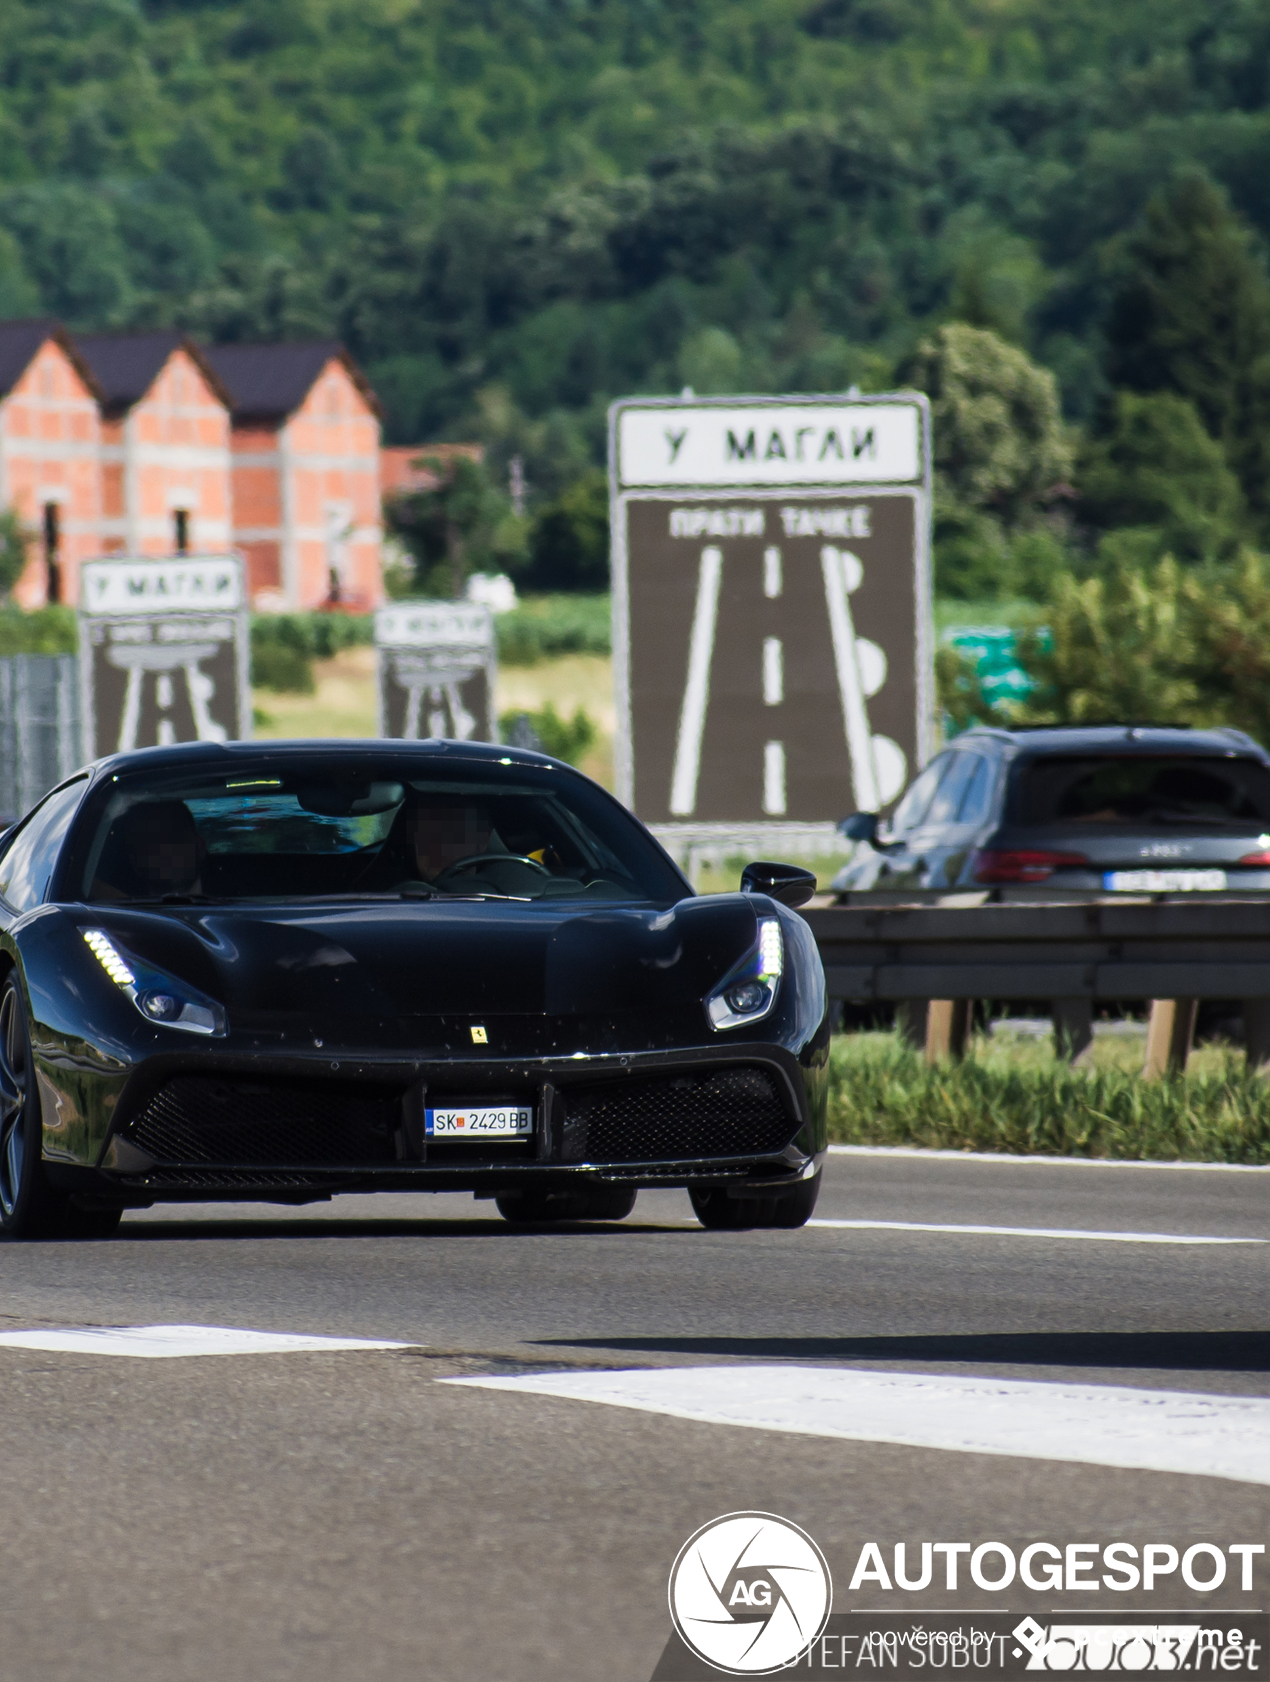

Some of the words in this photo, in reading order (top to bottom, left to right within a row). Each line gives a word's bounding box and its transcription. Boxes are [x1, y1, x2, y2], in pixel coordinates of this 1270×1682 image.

[664, 427, 688, 464] У
[727, 426, 876, 461] МАГЛИ
[669, 507, 765, 537] ПРАТИ
[781, 504, 872, 538] ТАЧКЕ
[436, 1113, 456, 1130] SK
[469, 1112, 506, 1130] 2429
[509, 1111, 528, 1129] BB
